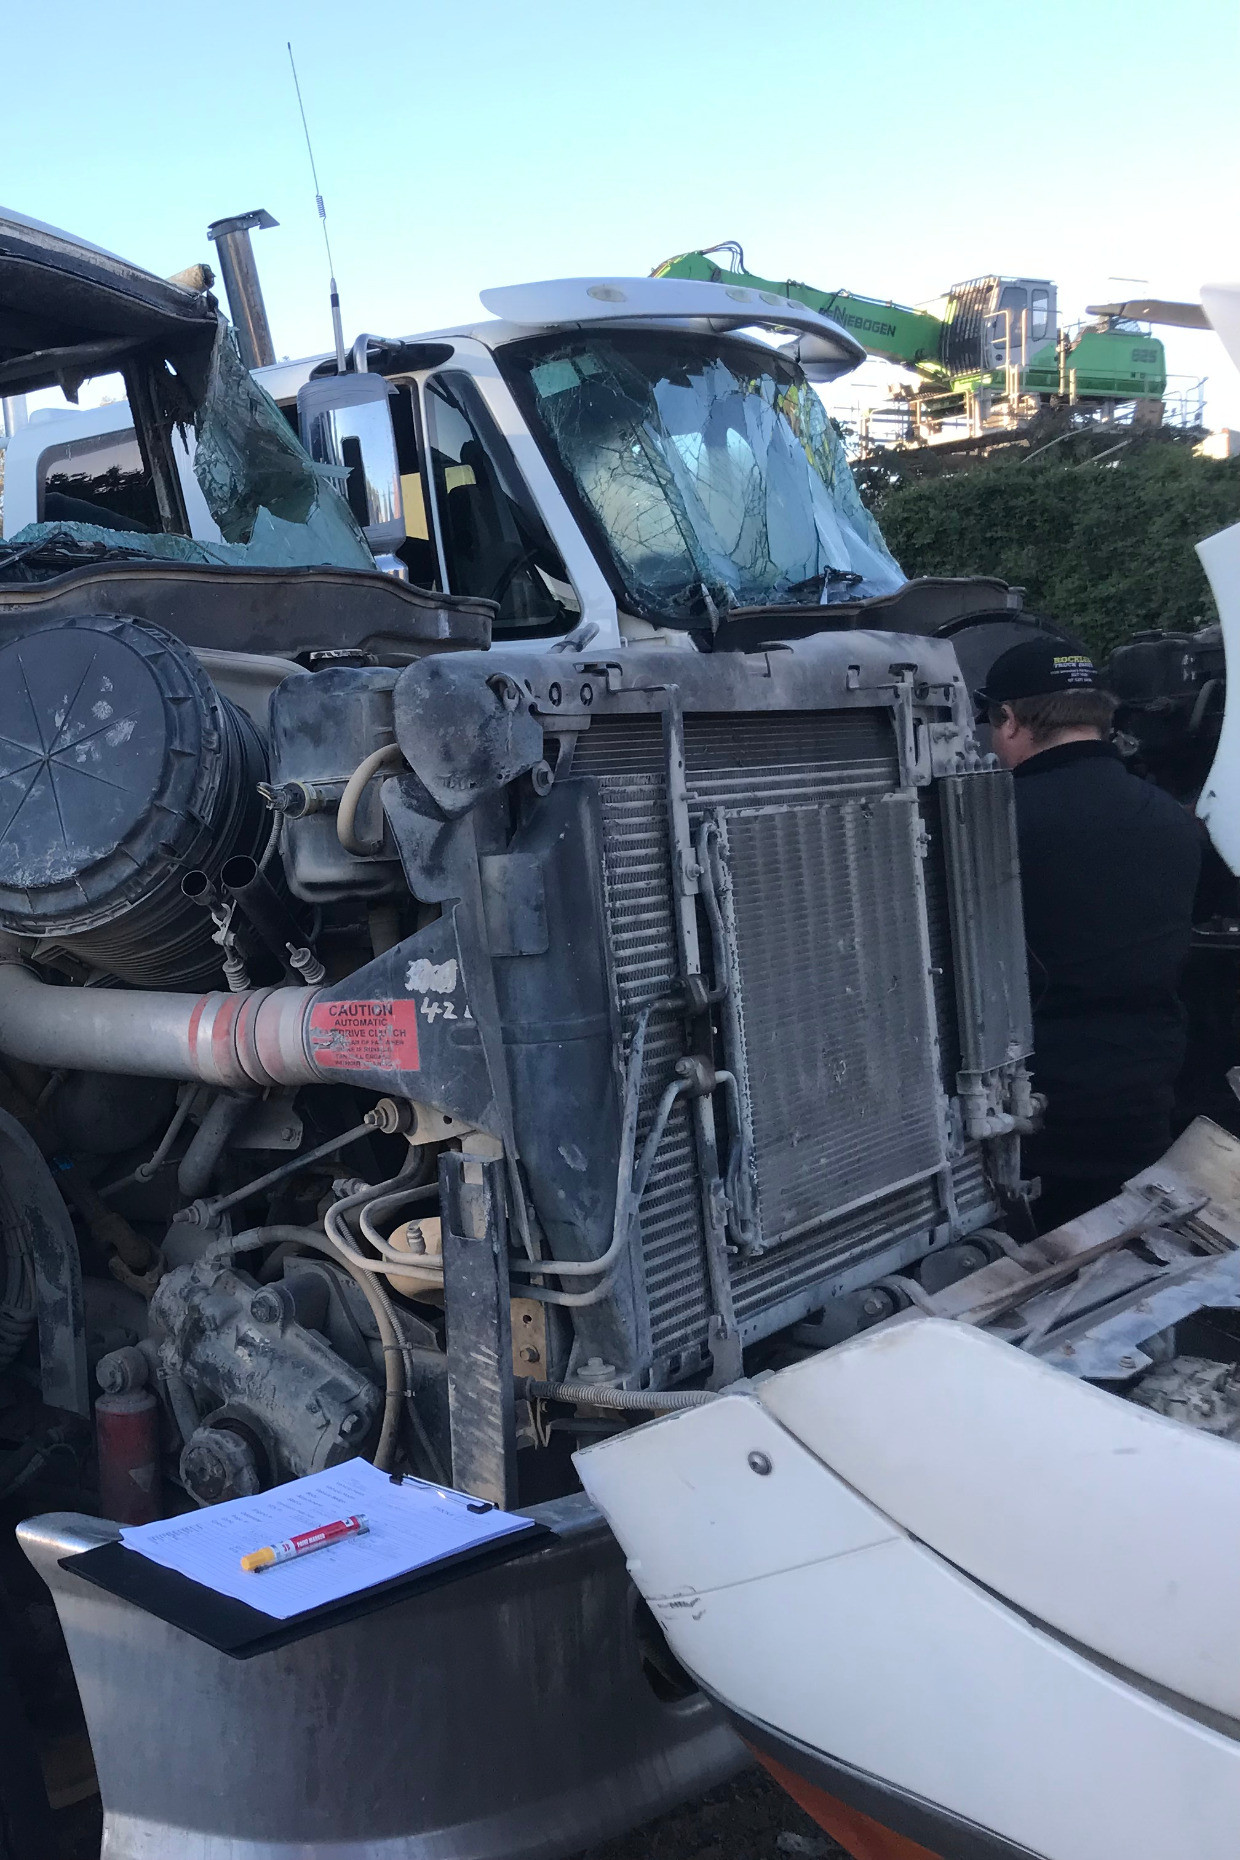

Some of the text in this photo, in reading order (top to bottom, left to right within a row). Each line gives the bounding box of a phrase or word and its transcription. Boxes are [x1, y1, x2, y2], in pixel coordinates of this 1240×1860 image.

[329, 1004, 393, 1017] CAUTION
[334, 1018, 388, 1027] AUTOMATIC
[368, 1028, 407, 1037] CLUCH
